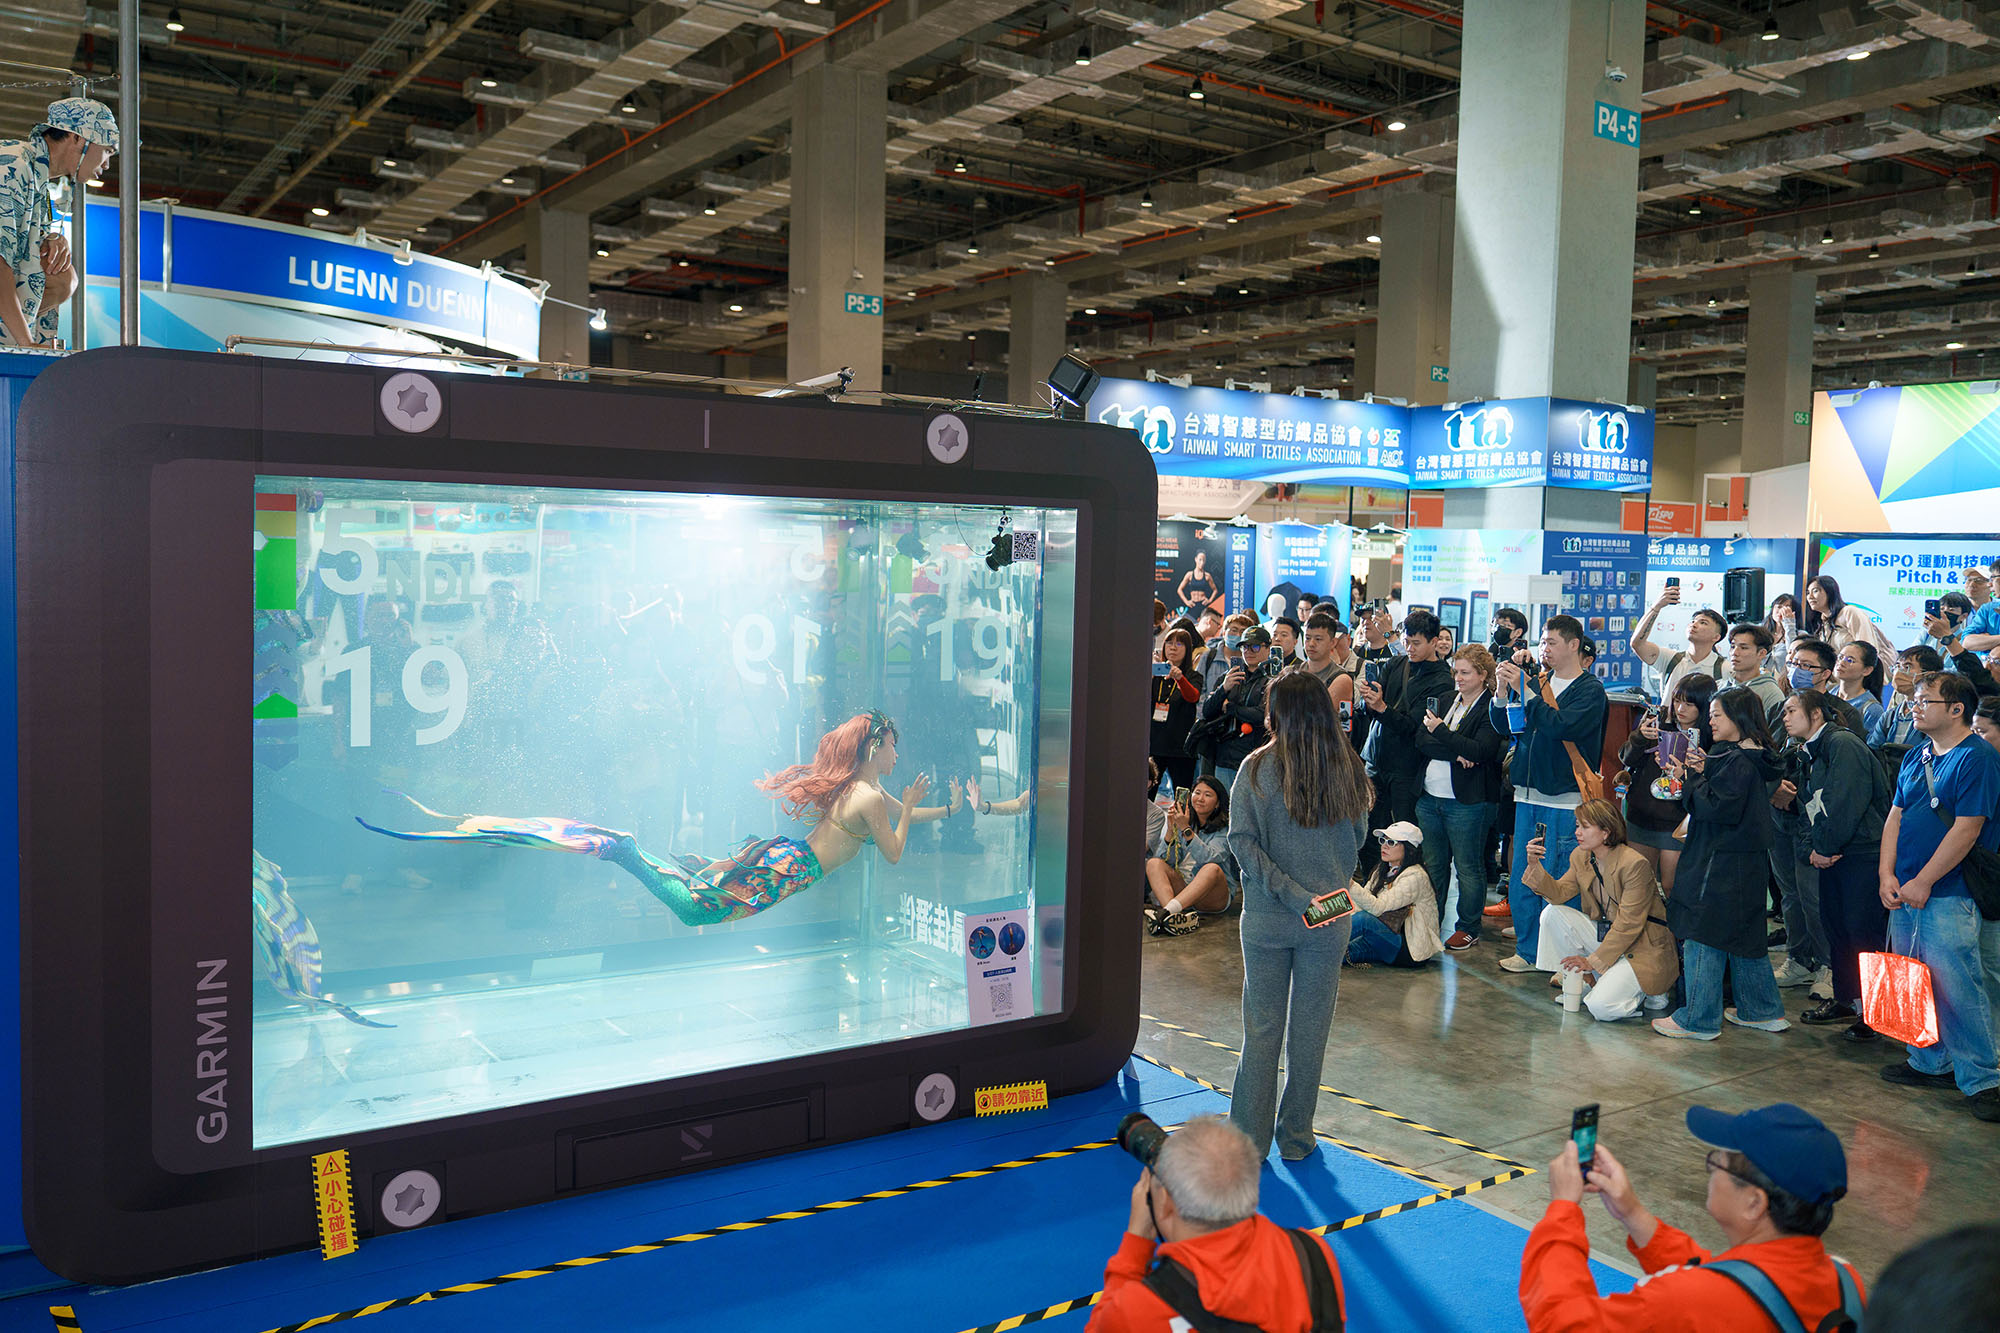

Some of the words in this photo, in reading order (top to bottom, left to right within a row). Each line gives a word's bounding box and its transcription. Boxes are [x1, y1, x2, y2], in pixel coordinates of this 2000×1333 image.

[1598, 105, 1637, 143] P4-5
[288, 256, 398, 304] LUENN
[407, 281, 485, 322] DUENN
[847, 294, 880, 314] P5-5
[1183, 411, 1363, 448] 台灣智慧型紡織品協會
[1182, 437, 1218, 456] TAIWAN
[1223, 440, 1256, 458] SMART
[1261, 443, 1301, 461] TEXTILES
[1306, 445, 1362, 466] ASSOCIATION
[1415, 450, 1543, 470] 台灣智慧型紡織品協會
[1552, 451, 1648, 473] 台灣智慧型紡織品協會
[1415, 470, 1438, 481] TAIWAN
[1440, 469, 1462, 481] SMART
[1466, 468, 1495, 480] TEXTILES
[1498, 466, 1542, 479] ASSOCIATION
[1551, 468, 1571, 479] TAIWAN
[1573, 469, 1590, 481] SMART
[1593, 470, 1615, 482] TEXTILES
[1616, 471, 1648, 485] ASSOCIATION
[319, 509, 379, 595] 5
[386, 558, 487, 603] NDL
[1670, 557, 1711, 567] ASSOCIATION
[1853, 554, 1913, 568] TaiSPO
[1917, 554, 2000, 568] 運動科技創
[1897, 569, 1942, 584] Pitch
[1946, 572, 1959, 584] &
[325, 644, 469, 747] 19
[196, 958, 228, 1144] GARMIN
[992, 1087, 1045, 1108] 請勿靠近
[324, 1178, 349, 1252] 小心碰撞
